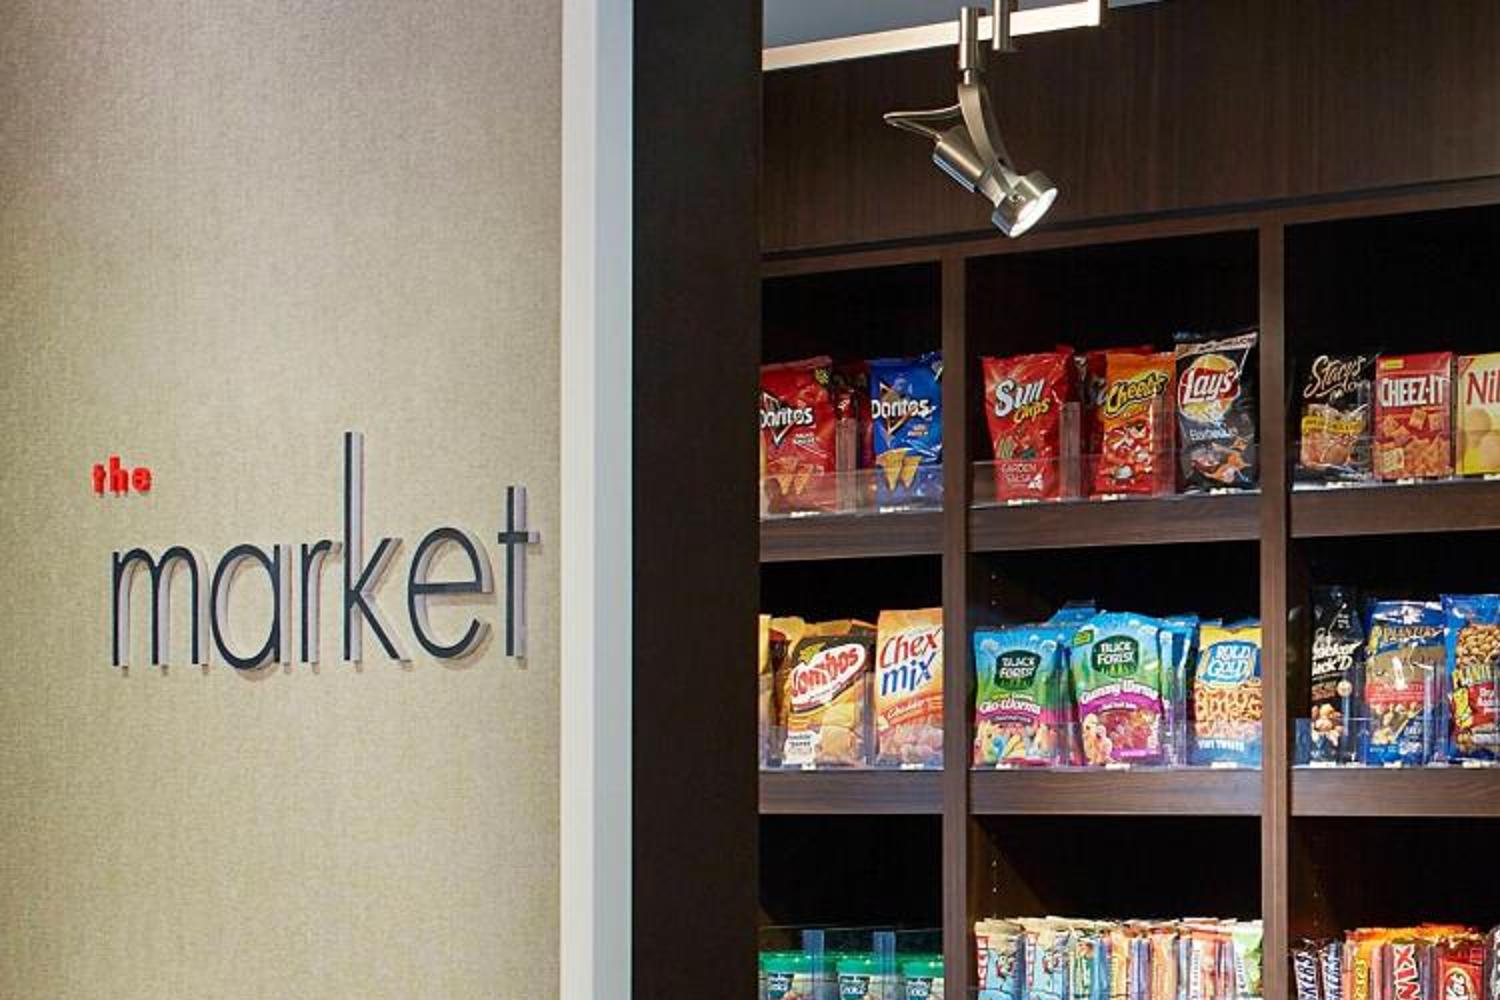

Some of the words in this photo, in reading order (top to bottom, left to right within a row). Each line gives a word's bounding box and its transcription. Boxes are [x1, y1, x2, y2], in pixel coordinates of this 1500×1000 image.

[871, 399, 932, 419] Doritos
[995, 378, 1045, 417] Sun
[1104, 371, 1169, 416] Cheetos
[1380, 374, 1448, 408] CHEEZ-IT
[92, 456, 152, 494] the
[112, 431, 540, 674] market
[880, 629, 942, 668] Chex
